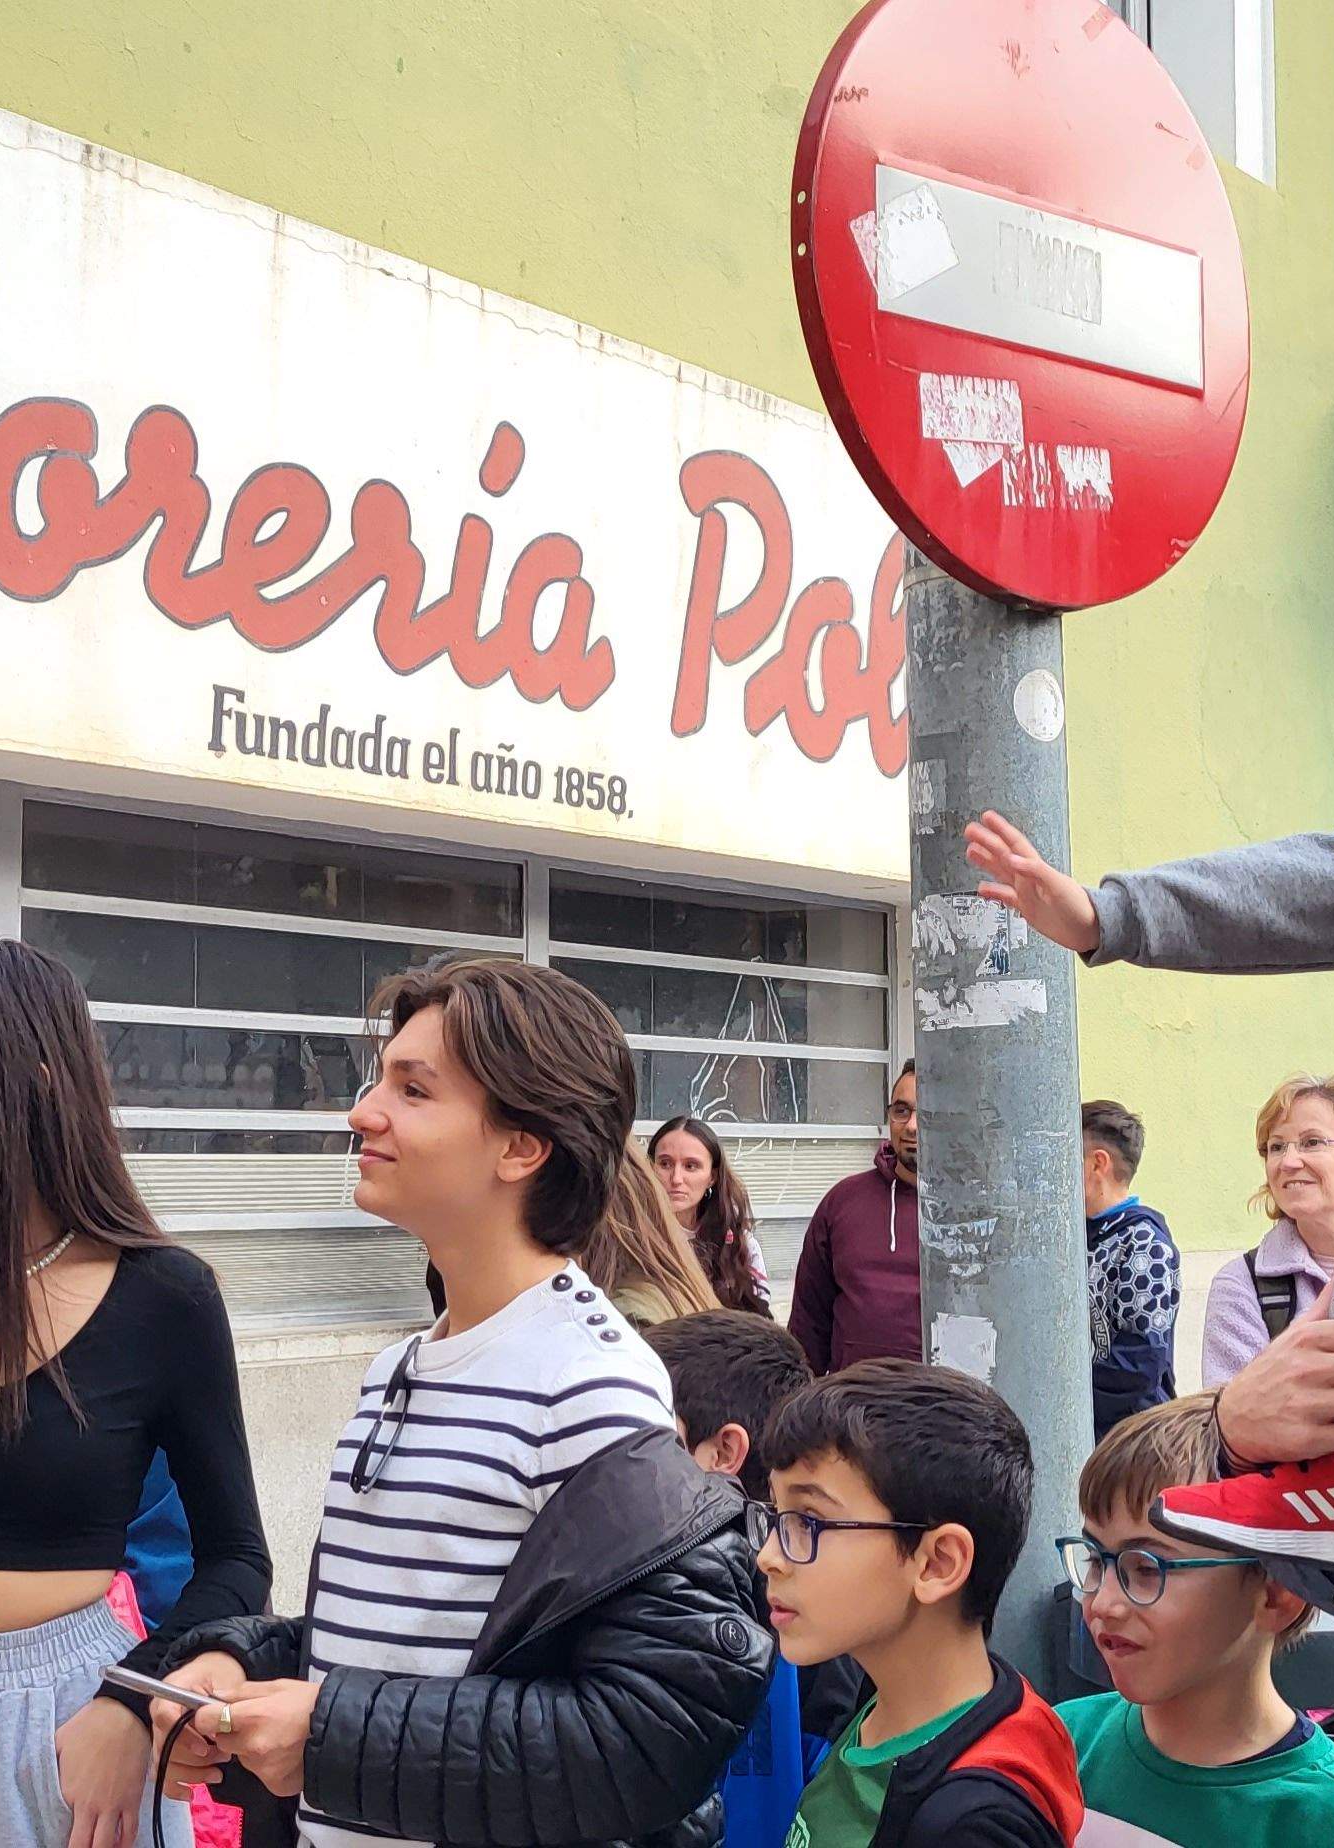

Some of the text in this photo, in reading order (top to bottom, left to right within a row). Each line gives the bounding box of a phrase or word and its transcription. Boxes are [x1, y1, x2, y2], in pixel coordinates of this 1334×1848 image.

[670, 449, 908, 779] Pol
[207, 684, 412, 780] Fundada
[422, 728, 461, 786] el
[470, 743, 543, 801] año
